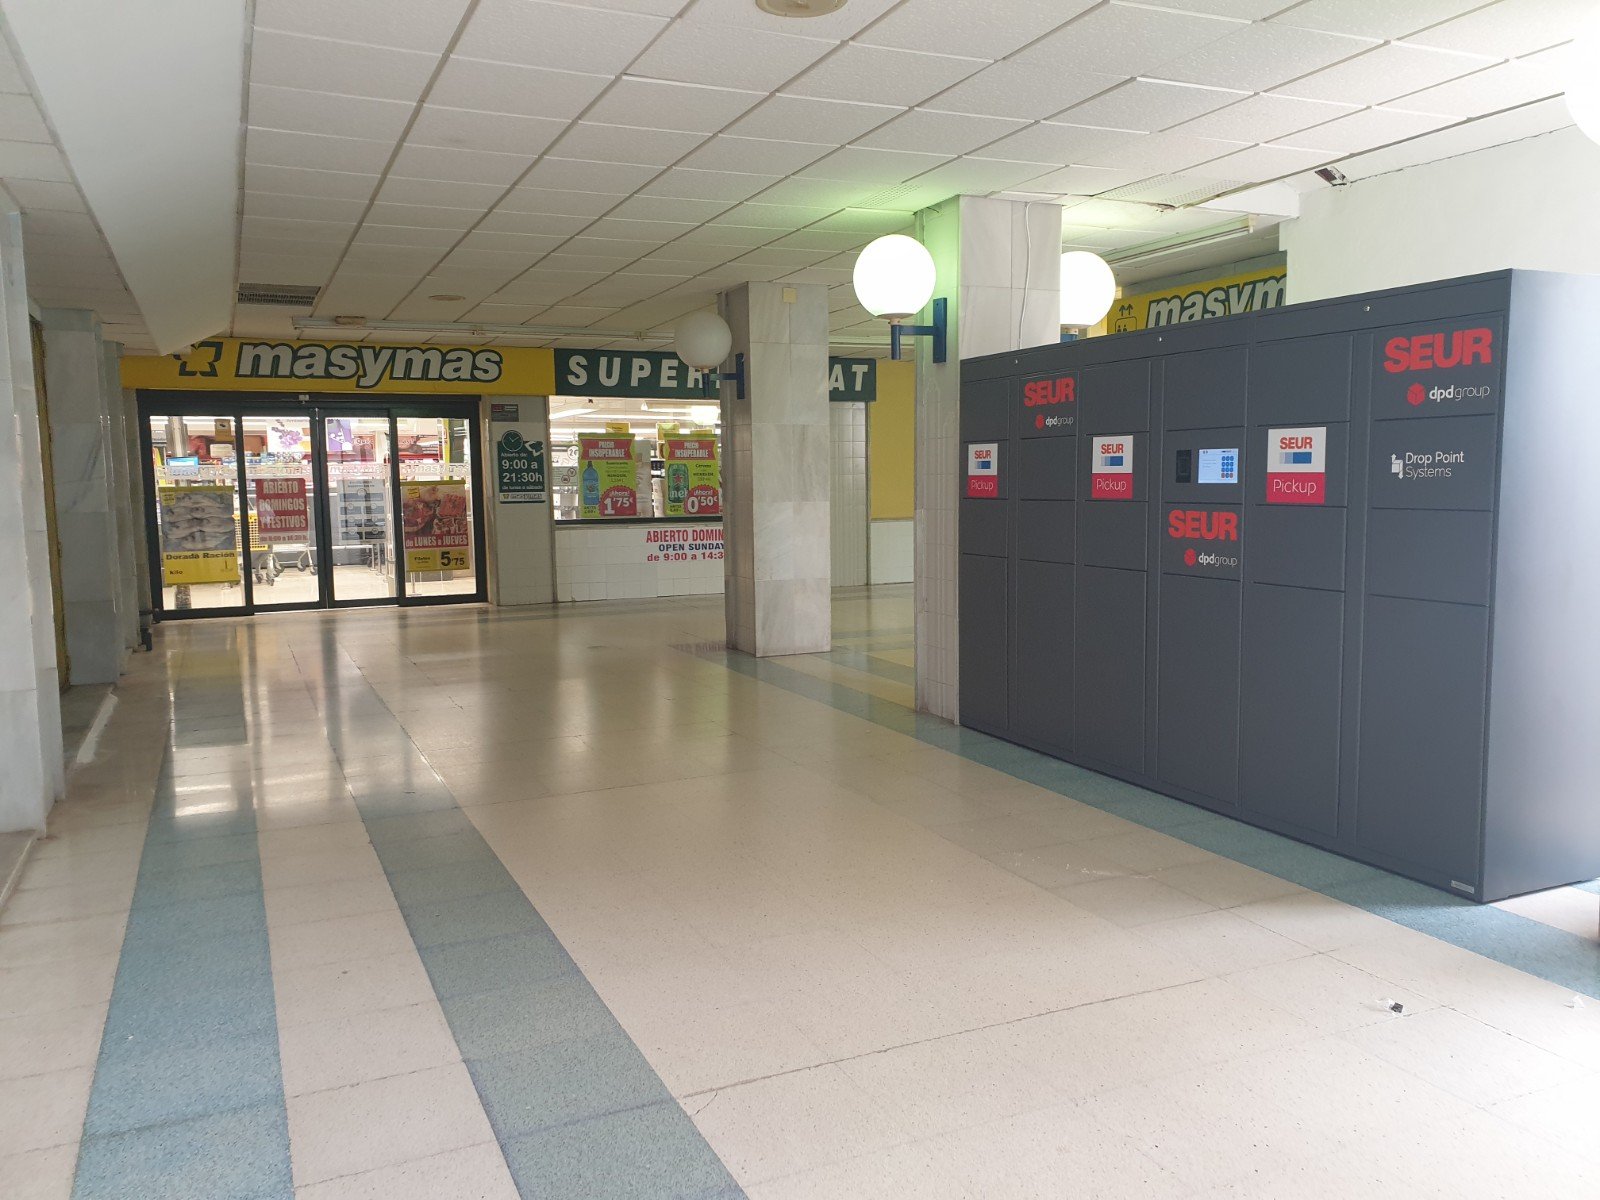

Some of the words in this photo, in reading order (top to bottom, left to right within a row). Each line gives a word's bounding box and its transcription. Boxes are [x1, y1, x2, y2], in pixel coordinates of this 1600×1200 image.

[1146, 274, 1287, 329] masym
[1384, 328, 1492, 373] SEUR
[235, 342, 503, 388] masymas
[1024, 377, 1075, 407] SEUR
[1429, 385, 1490, 402] dpdgroup
[1046, 416, 1074, 427] dpdgroup
[1101, 444, 1124, 454] SEUR
[1280, 437, 1313, 449] SEUR
[589, 449, 625, 457] INSUPERABLE
[975, 450, 992, 459] SEUR
[1405, 452, 1432, 465] Drop
[1435, 451, 1465, 463] Point
[502, 460, 528, 469] 9:00
[531, 461, 538, 469] a
[503, 472, 543, 482] 21:30h
[1405, 466, 1452, 480] Systems
[263, 480, 298, 493] ABIERTO
[971, 480, 993, 491] Pickup
[1096, 479, 1127, 491] Pickup
[1273, 479, 1317, 496] Pickup
[260, 498, 304, 511] DOMINGOS
[266, 515, 306, 528] FESTIVOS
[1168, 509, 1238, 541] SEUR
[415, 537, 436, 546] LUNES
[443, 535, 467, 545] JUEVES
[646, 529, 689, 543] ABIERTO
[692, 529, 725, 541] DOMIN
[647, 553, 659, 561] de
[663, 552, 687, 561] 9:00
[1199, 553, 1237, 567] dpdgroup
